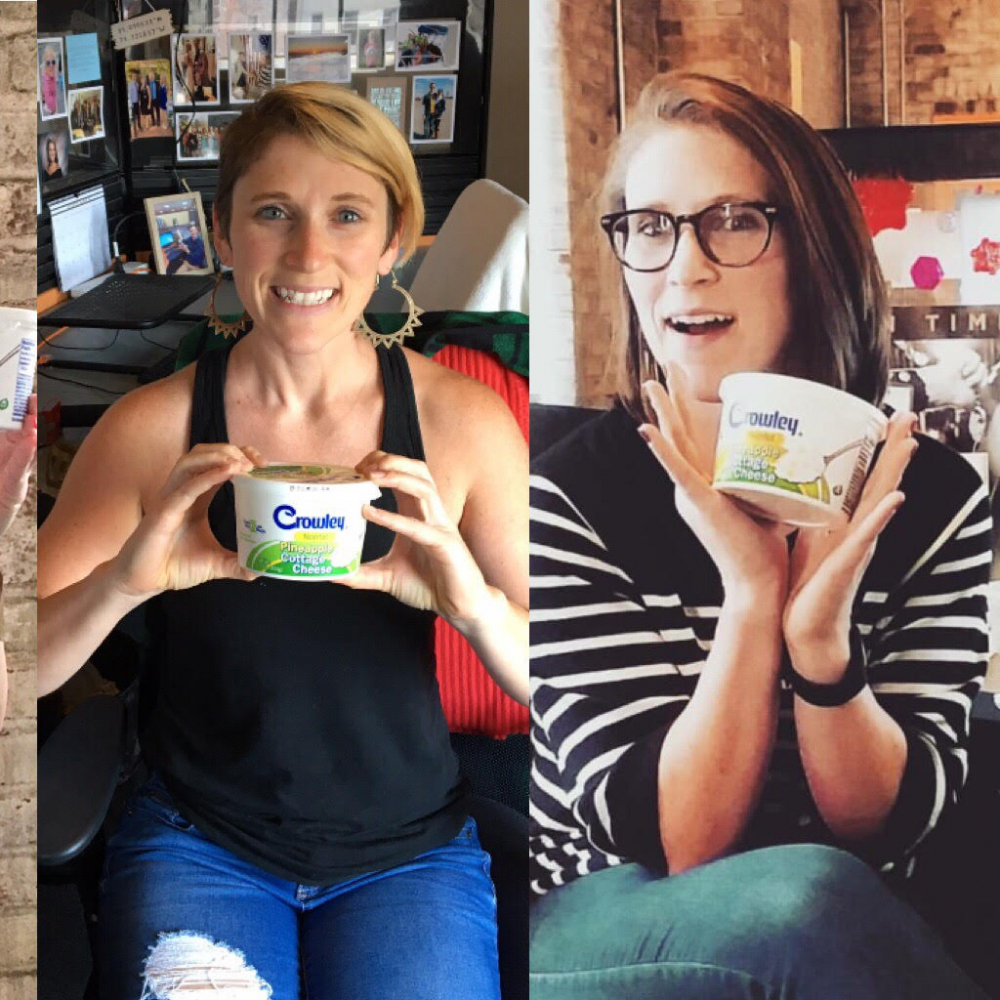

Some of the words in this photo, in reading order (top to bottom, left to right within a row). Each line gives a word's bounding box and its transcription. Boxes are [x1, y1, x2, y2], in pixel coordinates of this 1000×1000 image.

[925, 313, 1000, 333] TIM
[729, 403, 800, 436] Crowley
[273, 504, 345, 530] Crowley
[281, 552, 327, 566] Cottage
[293, 563, 332, 574] Cheese
